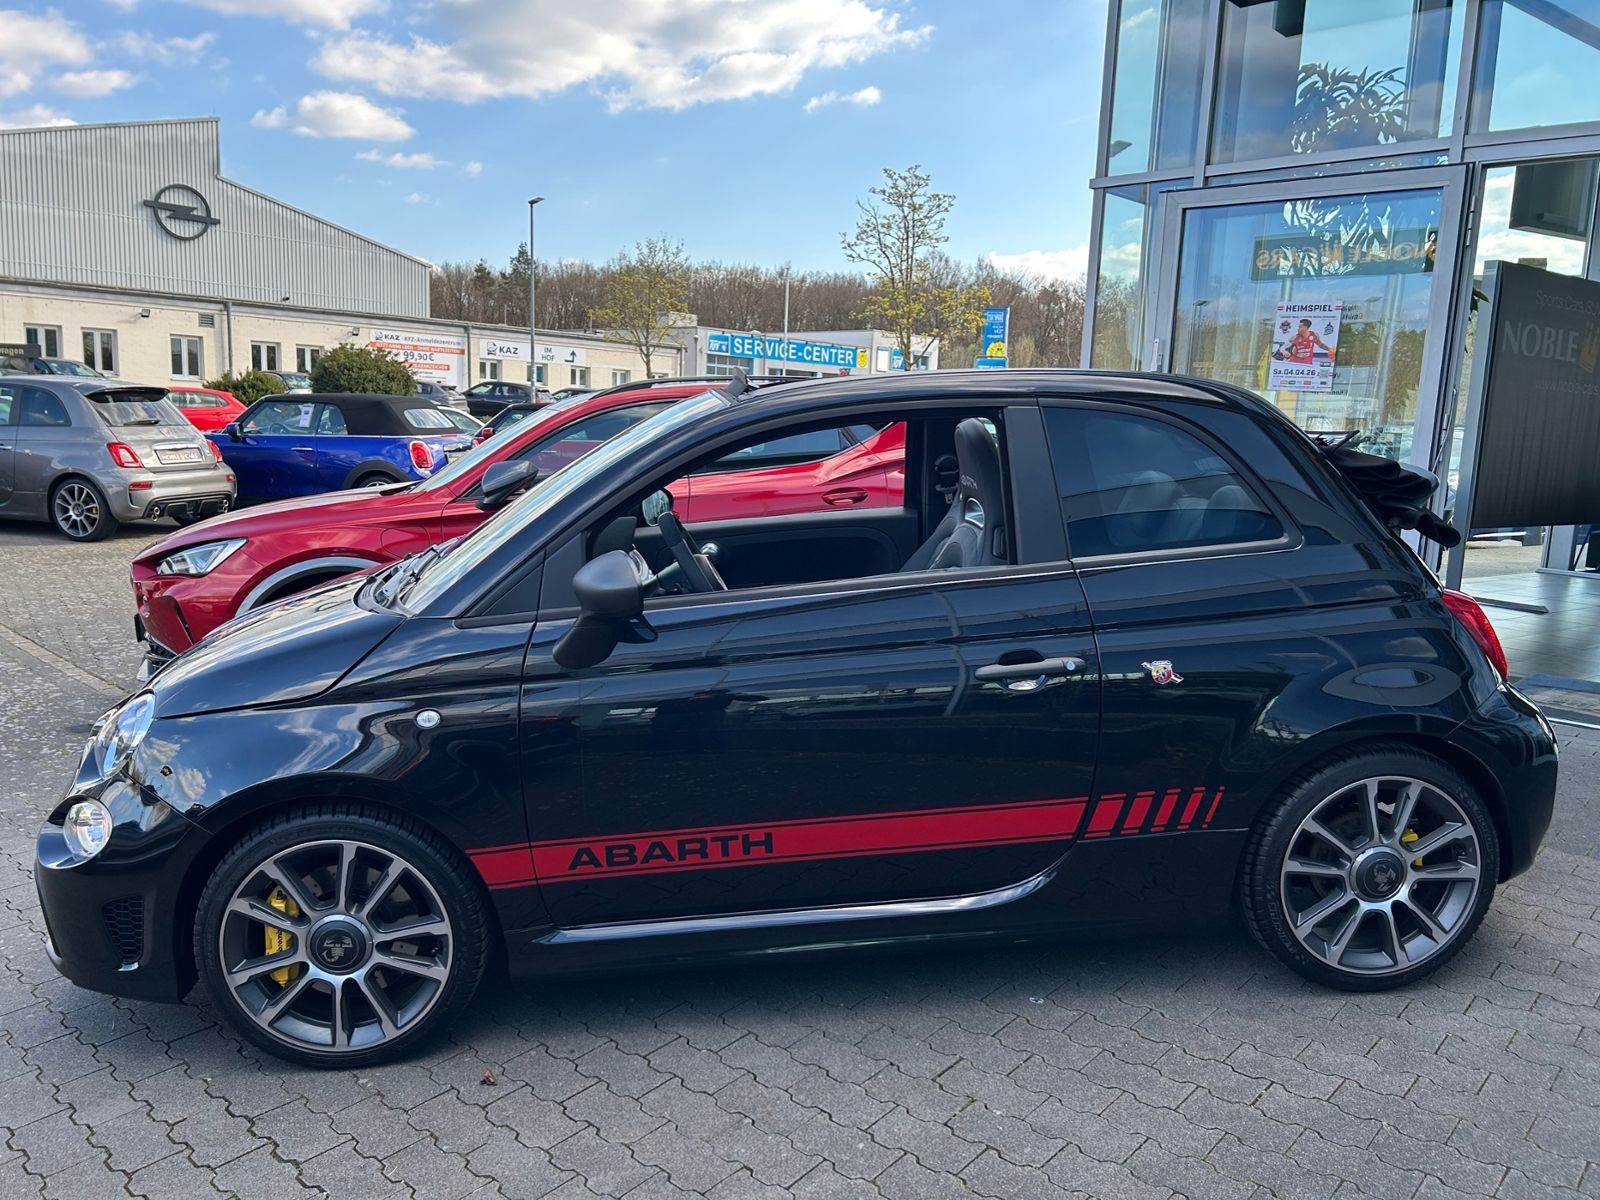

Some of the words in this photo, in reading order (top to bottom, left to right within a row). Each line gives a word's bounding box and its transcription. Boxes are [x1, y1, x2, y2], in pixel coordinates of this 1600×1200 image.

[1285, 304, 1333, 312] HEIMSPIEL
[384, 333, 400, 341] KAZ
[1502, 320, 1579, 362] NOBLE
[499, 345, 519, 355] KAZ
[733, 337, 854, 365] SERVICE-CENTER
[567, 831, 774, 871] ABARTH
